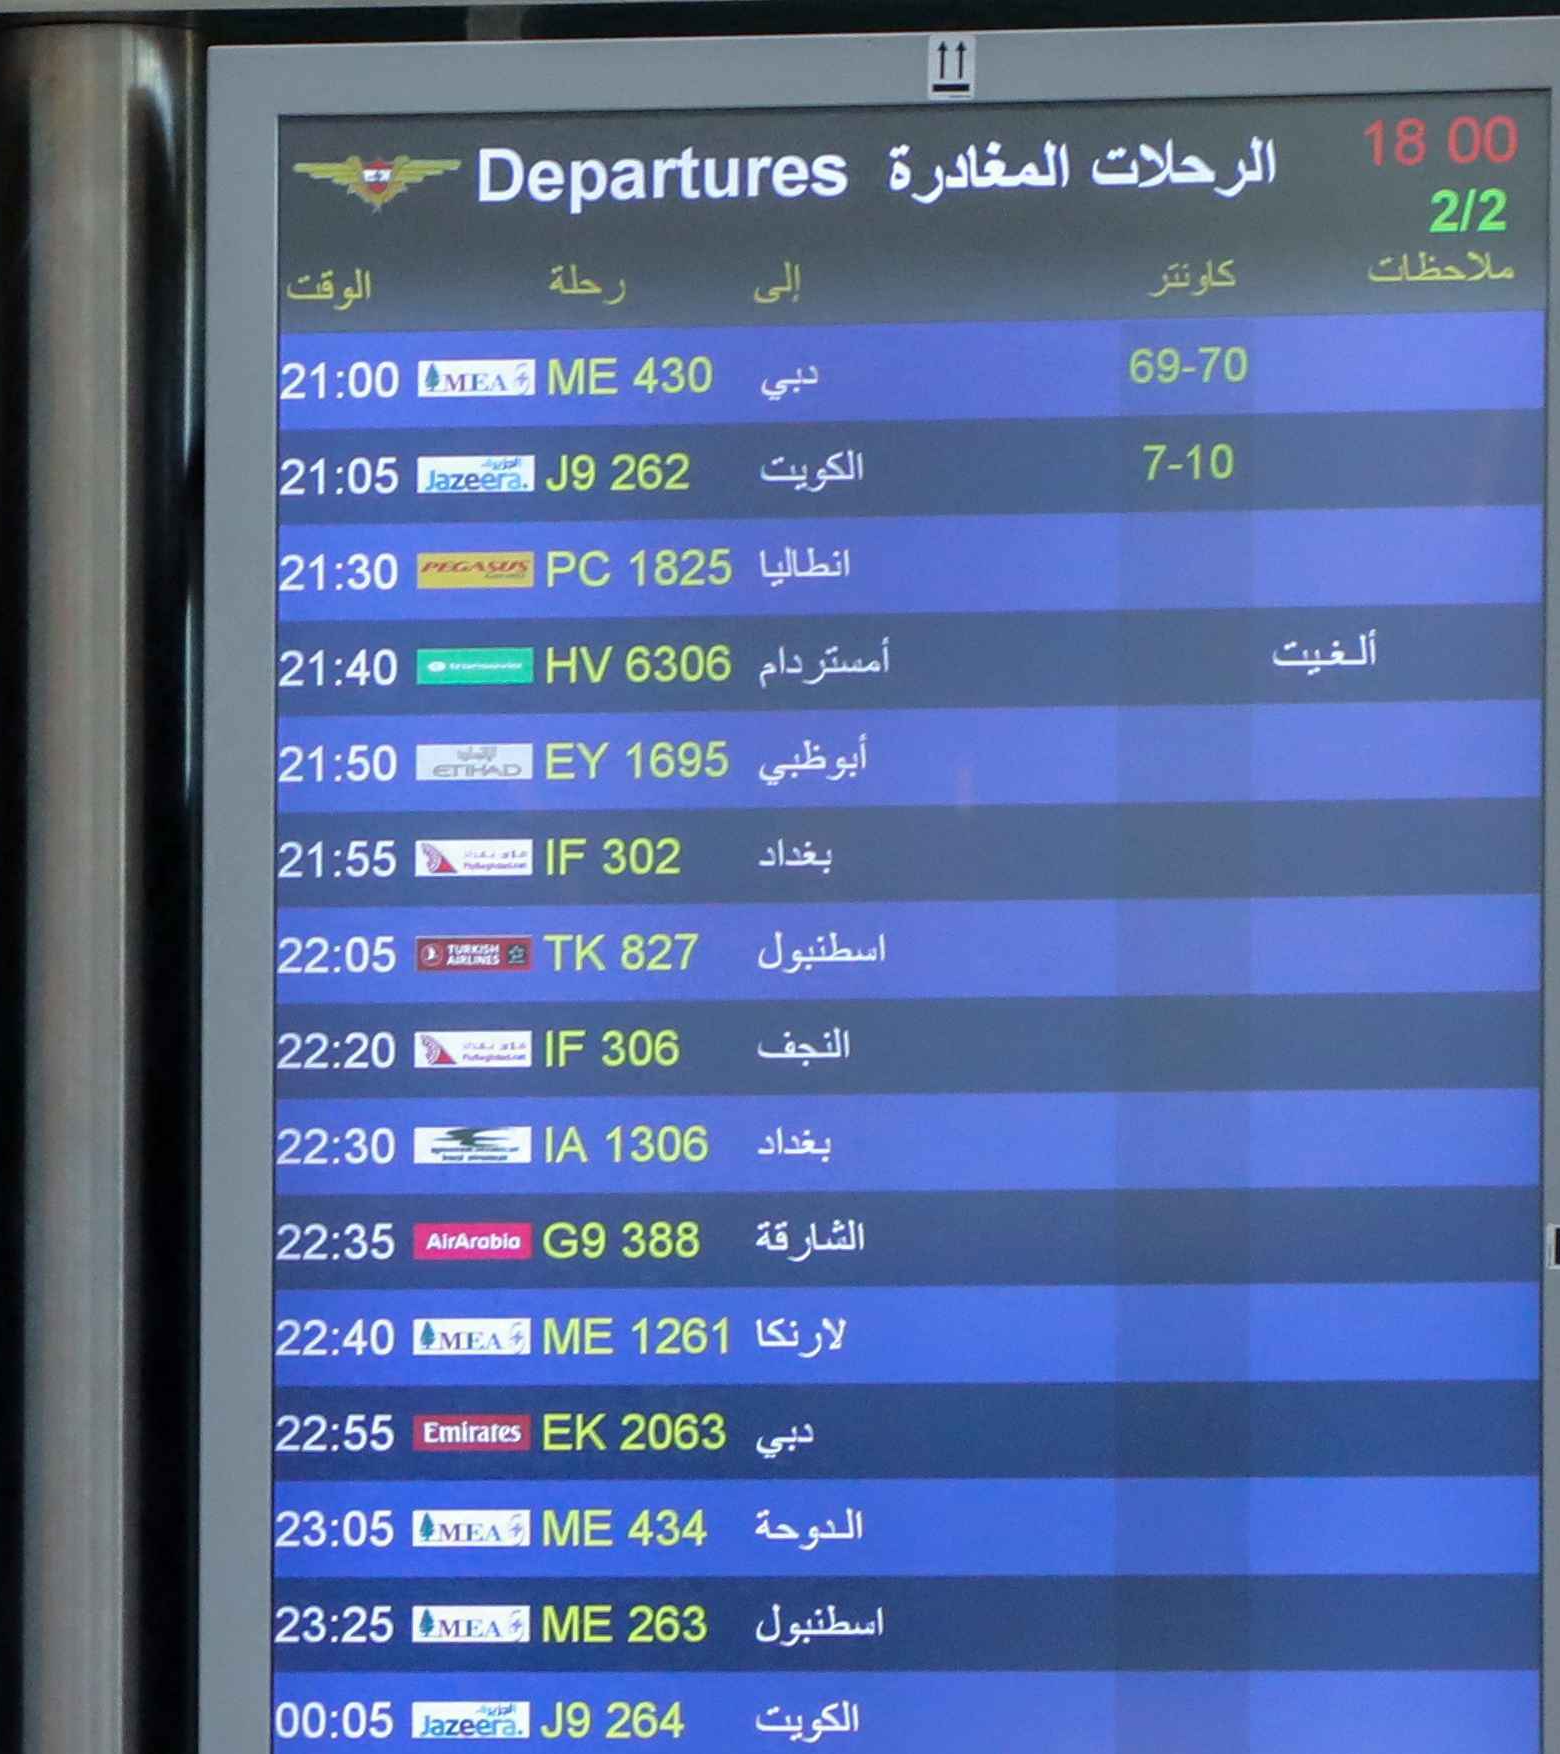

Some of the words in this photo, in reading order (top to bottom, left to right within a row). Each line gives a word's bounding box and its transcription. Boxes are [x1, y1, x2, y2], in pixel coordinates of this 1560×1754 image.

[479, 146, 848, 214] Departures
[889, 140, 1070, 204] المغادرة
[1092, 135, 1276, 198] الرحلات
[1429, 188, 1507, 233] 2/2
[549, 264, 625, 305] رحلة
[753, 262, 800, 303] إلى
[1150, 259, 1236, 297] كاونتر
[1369, 251, 1515, 282] ملاحظات
[287, 268, 371, 311] الوقت
[279, 361, 400, 400] 21:00
[548, 357, 619, 395] ME
[633, 356, 712, 394] 430
[444, 373, 506, 392] MEA
[760, 365, 819, 401] دبي
[1130, 346, 1247, 384] 69-70
[279, 456, 399, 496] 21:05
[545, 454, 596, 492] J9
[610, 452, 689, 491] 262
[761, 449, 863, 493] الكويت
[1143, 443, 1233, 481] 7-10
[279, 552, 398, 591] 21:30
[547, 550, 611, 588] PC
[629, 548, 732, 587] 1825
[421, 560, 530, 573] PEGASUS
[759, 546, 850, 588] انطاليا
[278, 648, 398, 687] 21:40
[546, 646, 613, 684] HV
[625, 644, 731, 683] 6306
[759, 636, 889, 688] أمستردام
[278, 744, 397, 783] 21:50
[546, 742, 610, 780] EY
[626, 740, 729, 779] 1695
[433, 763, 522, 778] ETIHAD
[758, 733, 867, 786] أبوظبي
[277, 935, 397, 974] 22:05
[543, 933, 606, 971] TK
[621, 933, 699, 971] 827
[758, 931, 886, 974] اسطنبول
[276, 1127, 396, 1165] 22:30
[545, 1126, 589, 1164] IA
[606, 1125, 708, 1163] 1306
[757, 1127, 831, 1163] بغداد
[426, 1232, 521, 1250] AirArabia
[275, 1318, 395, 1356] 22:40
[543, 1317, 614, 1355] ME
[632, 1316, 728, 1355] 1261
[755, 1317, 847, 1358] لارنكا
[423, 1422, 522, 1443] Emirates
[275, 1509, 394, 1548] 23:05
[543, 1509, 614, 1547] ME
[628, 1509, 708, 1547] 434
[275, 1701, 394, 1739] 00:05
[540, 1701, 591, 1739] J9
[605, 1701, 685, 1739] 264
[755, 1700, 859, 1743] الكويت
